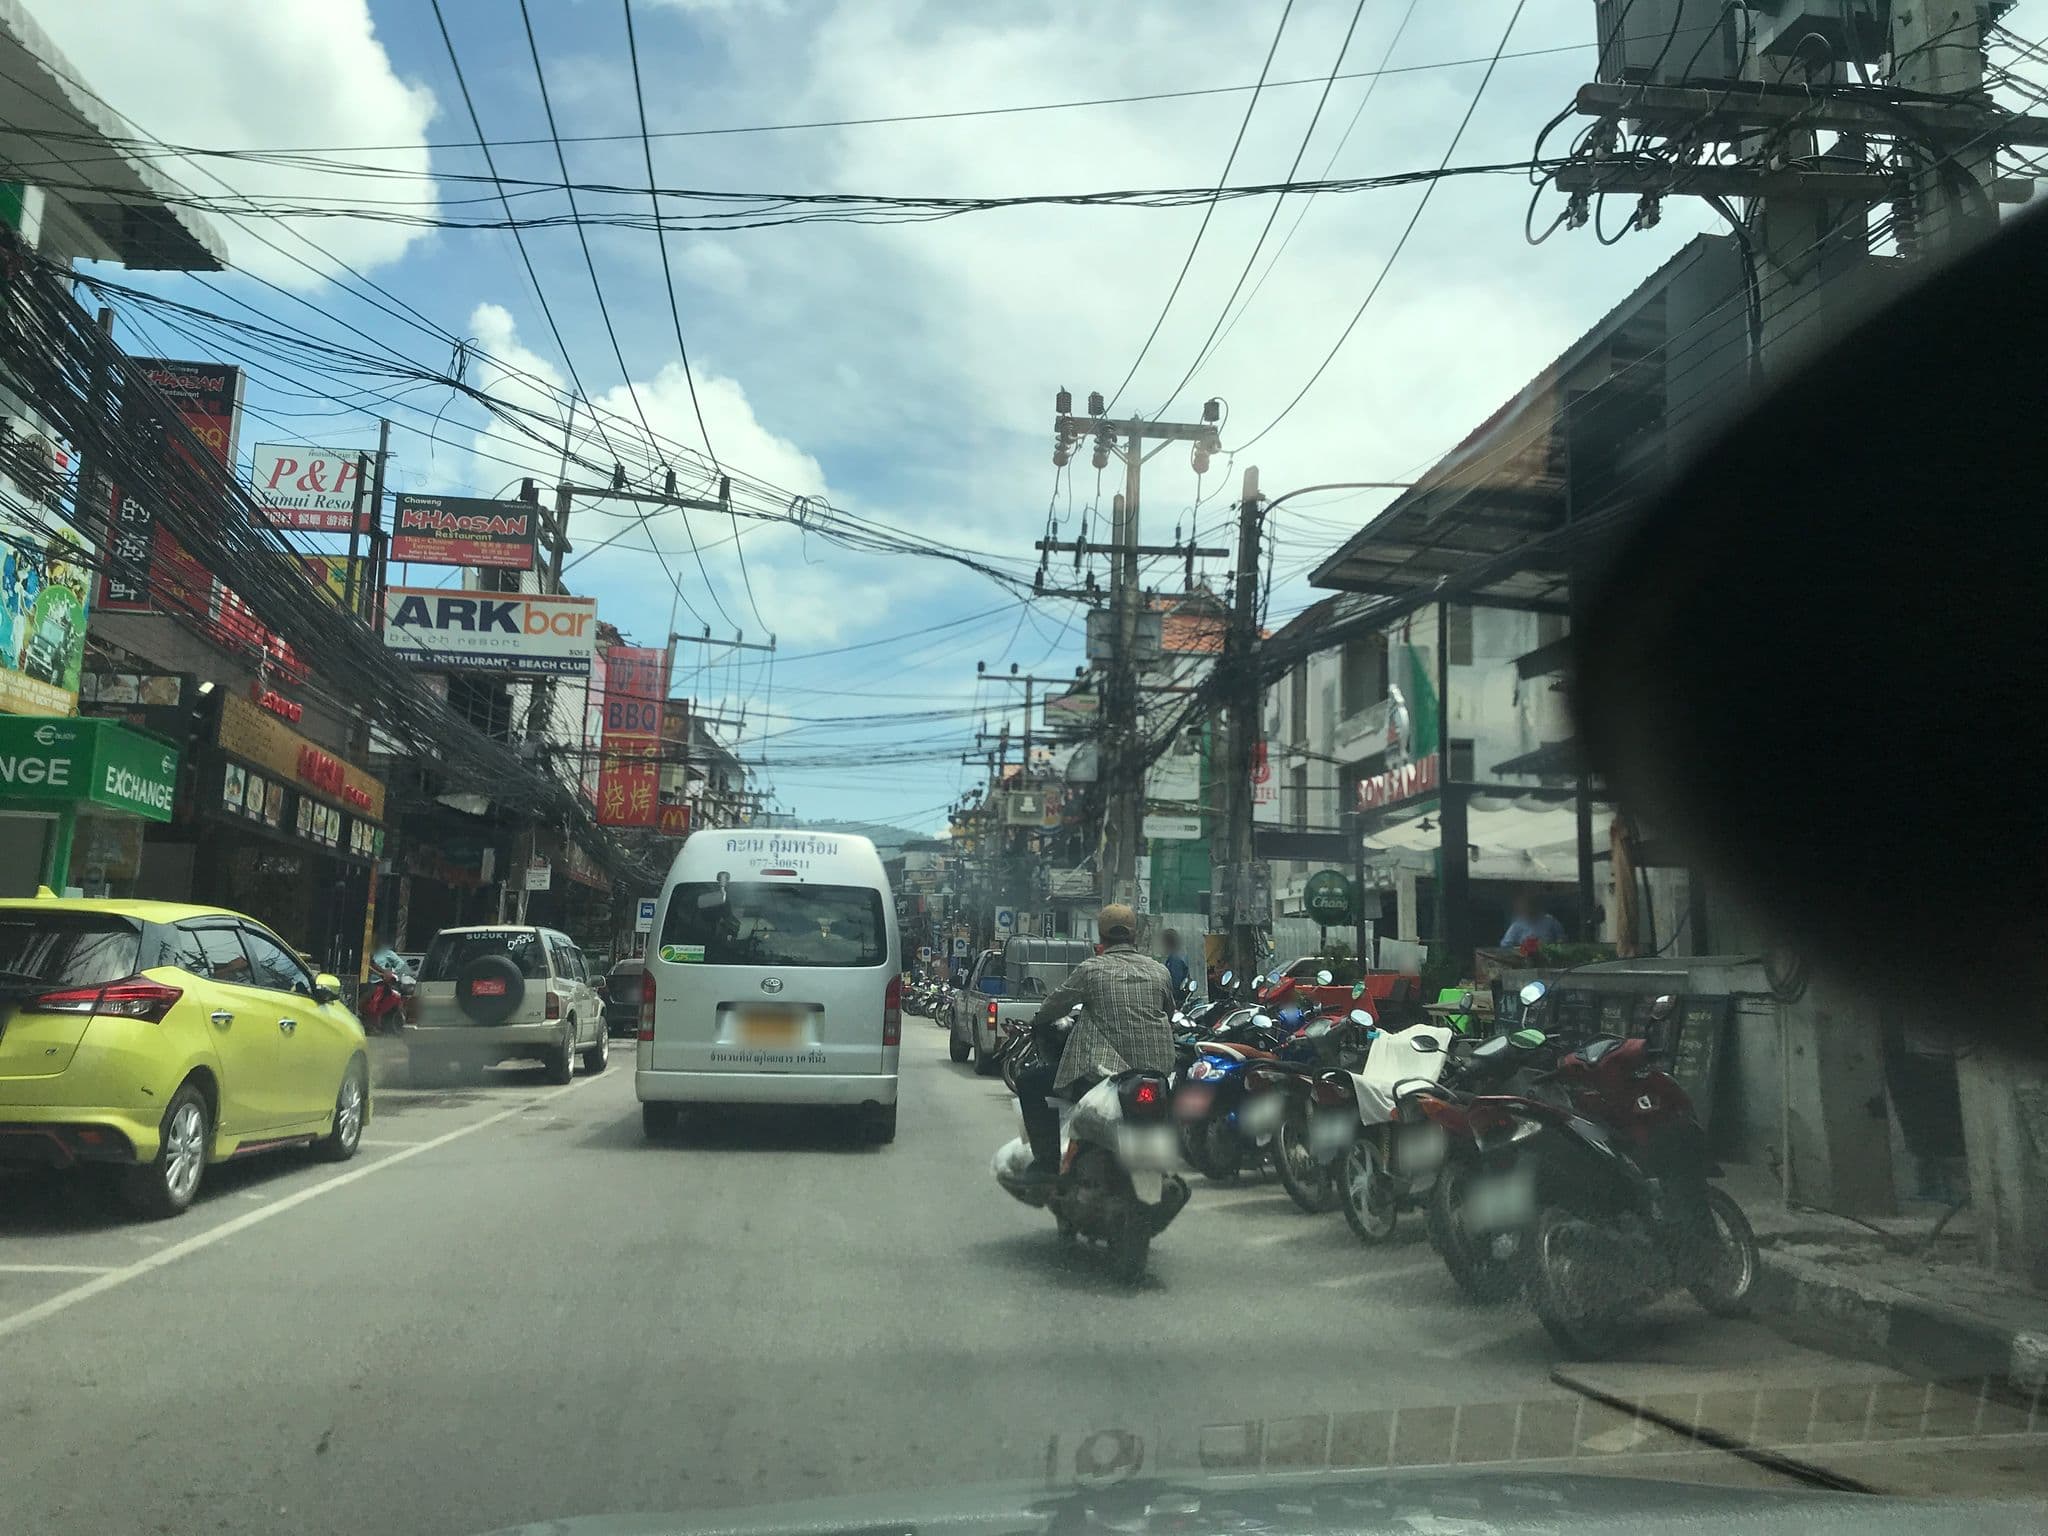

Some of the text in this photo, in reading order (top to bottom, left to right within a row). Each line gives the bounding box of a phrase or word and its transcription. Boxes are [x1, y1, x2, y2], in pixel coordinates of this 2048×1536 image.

[404, 497, 442, 507] Chaweng
[401, 509, 528, 535] KHAOSAN
[435, 530, 493, 541] Restaurant
[457, 638, 520, 648] resort
[519, 659, 557, 670] BEACH
[560, 660, 590, 671] CLUB
[608, 702, 656, 732] BBQ
[105, 765, 174, 810] EXCHANGE
[602, 779, 653, 821] 烧烤
[1312, 895, 1348, 910] Chang
[466, 932, 508, 940] SUZUKI
